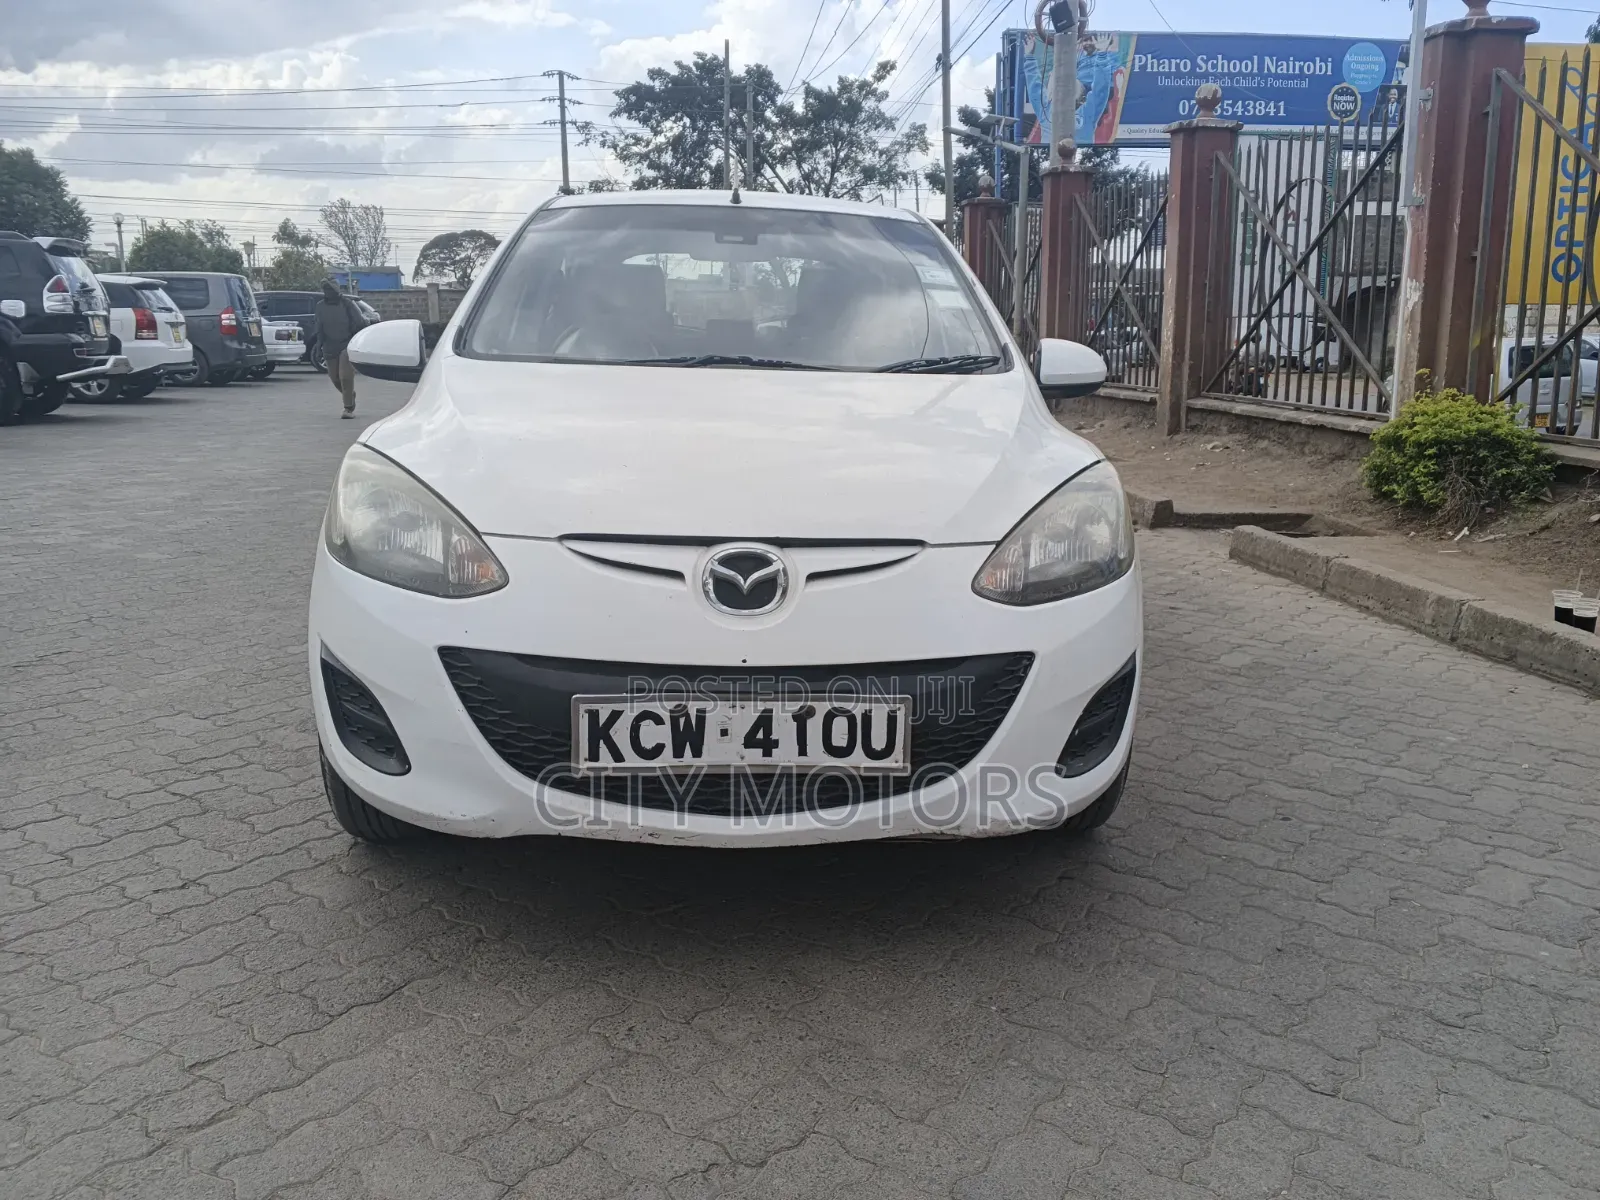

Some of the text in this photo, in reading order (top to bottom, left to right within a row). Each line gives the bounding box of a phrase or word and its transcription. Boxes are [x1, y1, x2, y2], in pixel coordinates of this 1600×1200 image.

[1344, 53, 1384, 62] Admissions
[1133, 54, 1333, 75] Pharo School Nairobi
[1350, 61, 1379, 71] Ongoing
[1157, 75, 1309, 88] Unlocking Each Child's Potential
[1333, 94, 1356, 102] Register
[1178, 99, 1287, 116] 073543841
[1333, 102, 1356, 110] NOW
[1126, 127, 1147, 135] Quality
[586, 706, 707, 763] KCW
[743, 706, 898, 761] 410U
